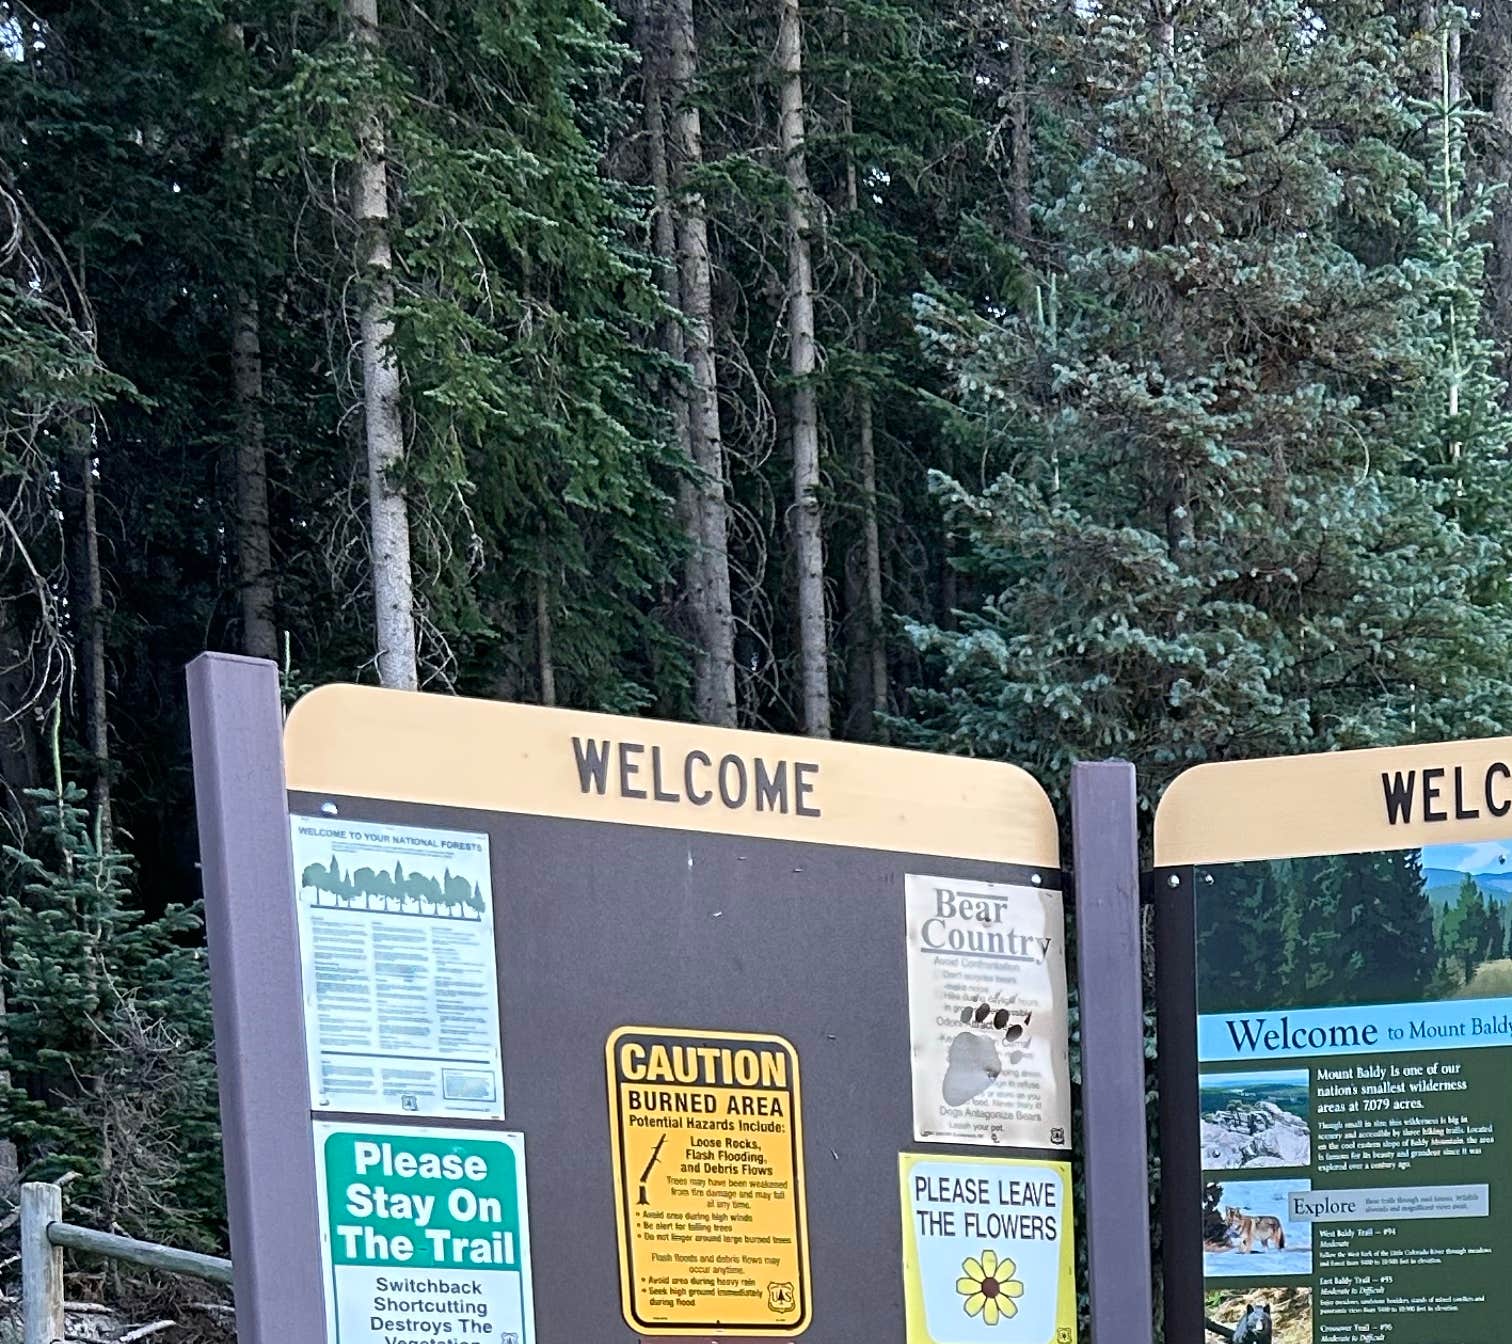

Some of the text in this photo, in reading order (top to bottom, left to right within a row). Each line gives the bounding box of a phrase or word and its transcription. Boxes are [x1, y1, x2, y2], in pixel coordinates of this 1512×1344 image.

[571, 736, 822, 818] WELCOME
[298, 826, 347, 839] WELCOME
[350, 831, 362, 841] TO
[364, 833, 390, 844] YOUR
[393, 835, 437, 847] NATIONAL
[441, 840, 483, 852] FORESTS
[935, 888, 1008, 924] Bear
[921, 918, 1052, 965] Country
[1226, 1016, 1378, 1053] Welcome
[1388, 1025, 1404, 1041] to
[1410, 1019, 1465, 1040] Mount
[620, 1042, 787, 1087] CAUTION
[1317, 1067, 1353, 1081] Mount
[1357, 1065, 1387, 1081] Baldy
[1403, 1066, 1422, 1077] one
[1426, 1063, 1439, 1075] of
[1441, 1063, 1461, 1075] our
[1361, 1081, 1405, 1095] smallest
[1409, 1079, 1467, 1092] wilderness
[628, 1090, 784, 1118] BURNED AREA
[1317, 1101, 1345, 1114] areas
[1349, 1100, 1359, 1112] at
[1393, 1098, 1424, 1110] acres.
[939, 1106, 1042, 1121] Dogs Antagonize Bears
[629, 1115, 786, 1134] Potential Hazards Include:
[973, 1124, 989, 1132] your
[690, 1136, 762, 1151] Loose Rocks,
[354, 1141, 488, 1181] Please
[686, 1150, 767, 1165] Flash Flooding,
[680, 1162, 773, 1176] and Debris Flows
[915, 1176, 1056, 1208] PLEASE LEAVE
[346, 1182, 502, 1227] Stay On
[1294, 1196, 1356, 1217] Explore
[643, 1210, 664, 1220] Avoid
[685, 1212, 710, 1222] during
[711, 1213, 728, 1222] high
[730, 1214, 752, 1223] winds
[916, 1210, 1057, 1241] THE FLOWERS
[643, 1220, 653, 1230] Be
[675, 1222, 685, 1230] for
[713, 1223, 732, 1232] trees
[1319, 1229, 1335, 1238] West
[1337, 1229, 1355, 1239] Baldy
[1357, 1228, 1373, 1237] Trail
[337, 1225, 515, 1265] The Trail
[651, 1253, 672, 1263] Flash
[700, 1255, 714, 1263] and
[716, 1254, 740, 1264] debris
[742, 1255, 763, 1265] flows
[764, 1257, 780, 1267] may
[689, 1265, 710, 1274] occur
[376, 1277, 482, 1295] Switchback
[648, 1275, 669, 1285] Avoid
[672, 1277, 688, 1285] area
[690, 1277, 715, 1287] during
[717, 1277, 739, 1287] heavy
[1334, 1276, 1353, 1286] Baldy
[1355, 1276, 1371, 1284] Trail
[648, 1286, 763, 1299] Seek high ground immediately
[374, 1297, 488, 1317] Shortcutting
[649, 1298, 674, 1308] during
[370, 1316, 493, 1335] Destroys The
[1354, 1324, 1370, 1332] Trail
